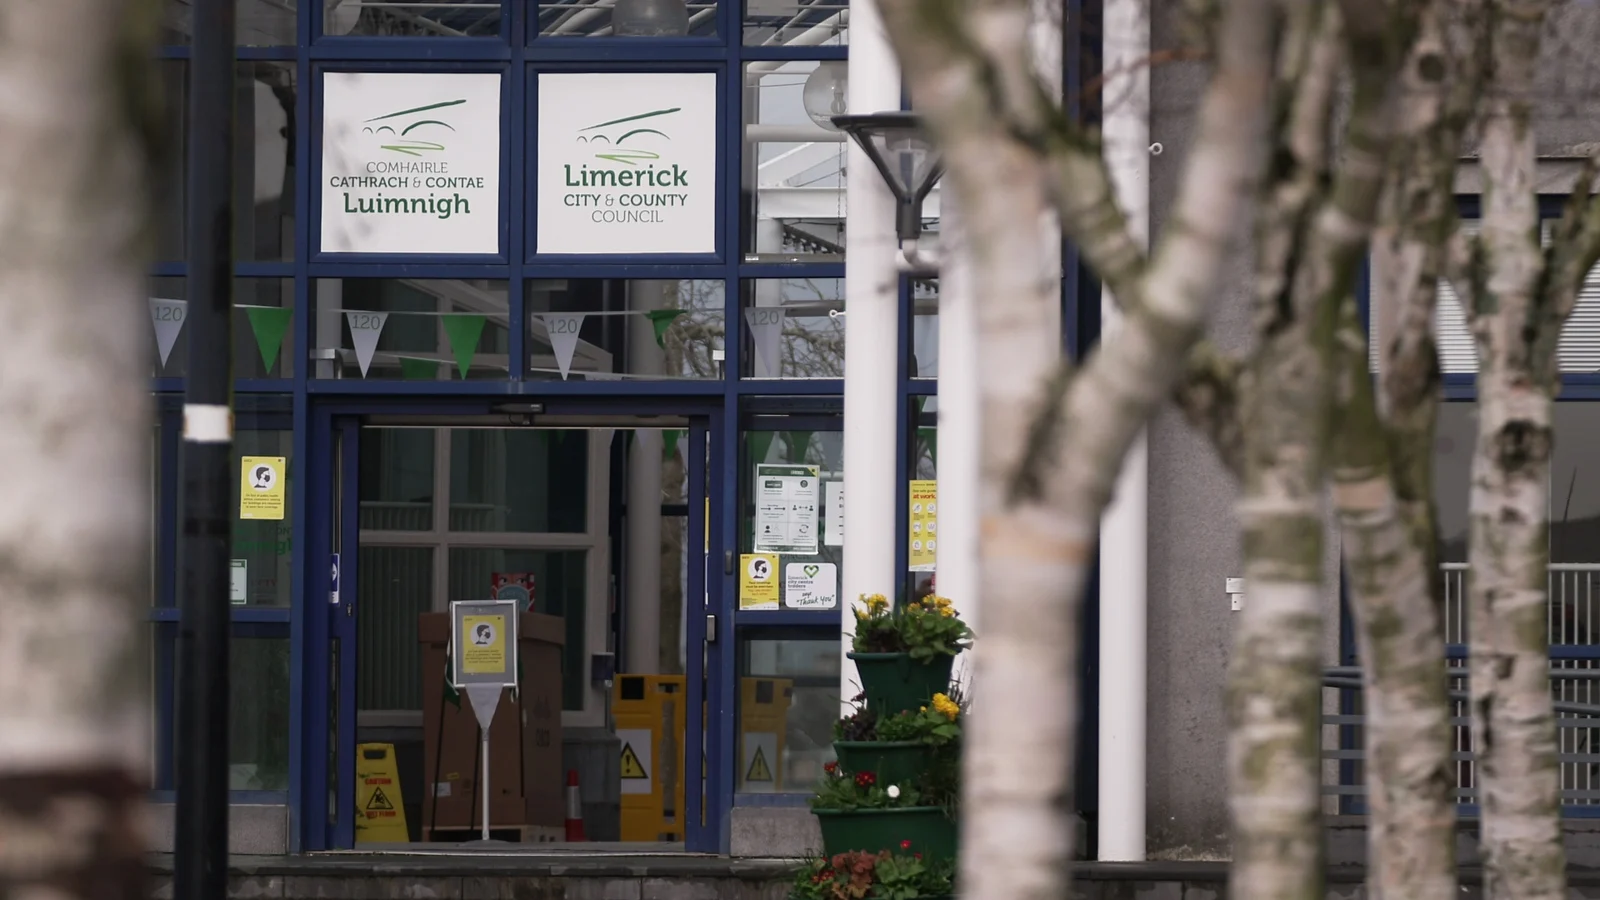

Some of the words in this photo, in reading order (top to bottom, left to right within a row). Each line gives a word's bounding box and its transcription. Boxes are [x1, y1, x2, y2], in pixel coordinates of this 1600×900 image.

[366, 161, 448, 174] COMHAIRLE
[330, 176, 409, 189] CATHRACH
[413, 177, 421, 189] &
[425, 176, 484, 189] CONTAE
[563, 164, 689, 187] Limerick
[343, 192, 471, 220] Luimnigh
[563, 193, 601, 207] CITY
[605, 194, 615, 207] &
[619, 193, 688, 207] COUNTY
[591, 210, 664, 223] COUNCIL
[153, 305, 183, 322] 120
[750, 310, 779, 326] 120
[352, 315, 381, 330] 120
[549, 318, 578, 334] 120
